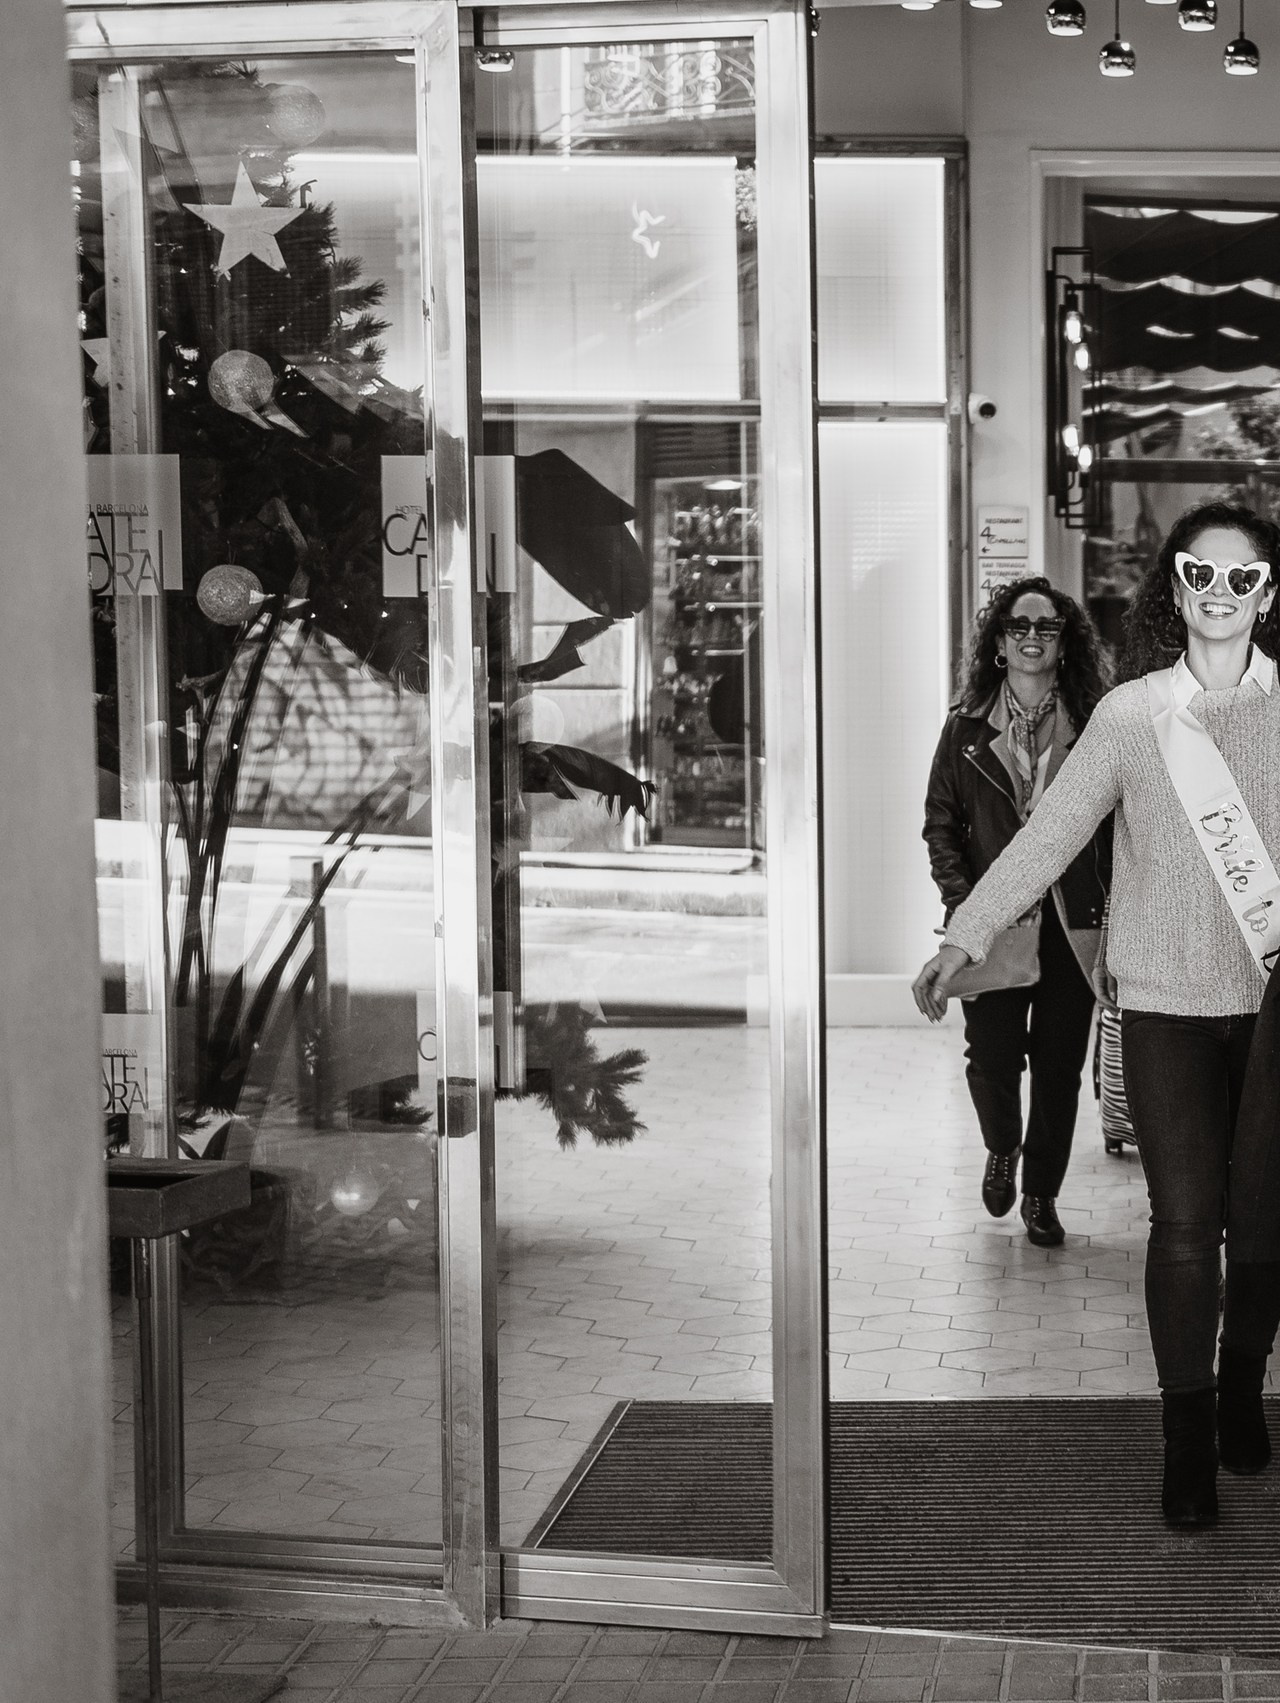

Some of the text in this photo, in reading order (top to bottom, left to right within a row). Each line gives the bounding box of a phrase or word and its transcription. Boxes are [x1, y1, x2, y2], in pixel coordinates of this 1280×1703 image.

[96, 503, 149, 514] BARCELONA
[87, 511, 149, 555] ATE
[980, 526, 997, 538] 4
[1199, 801, 1265, 894] Bride
[1241, 895, 1274, 938] to
[104, 1048, 138, 1057] ARCELONA
